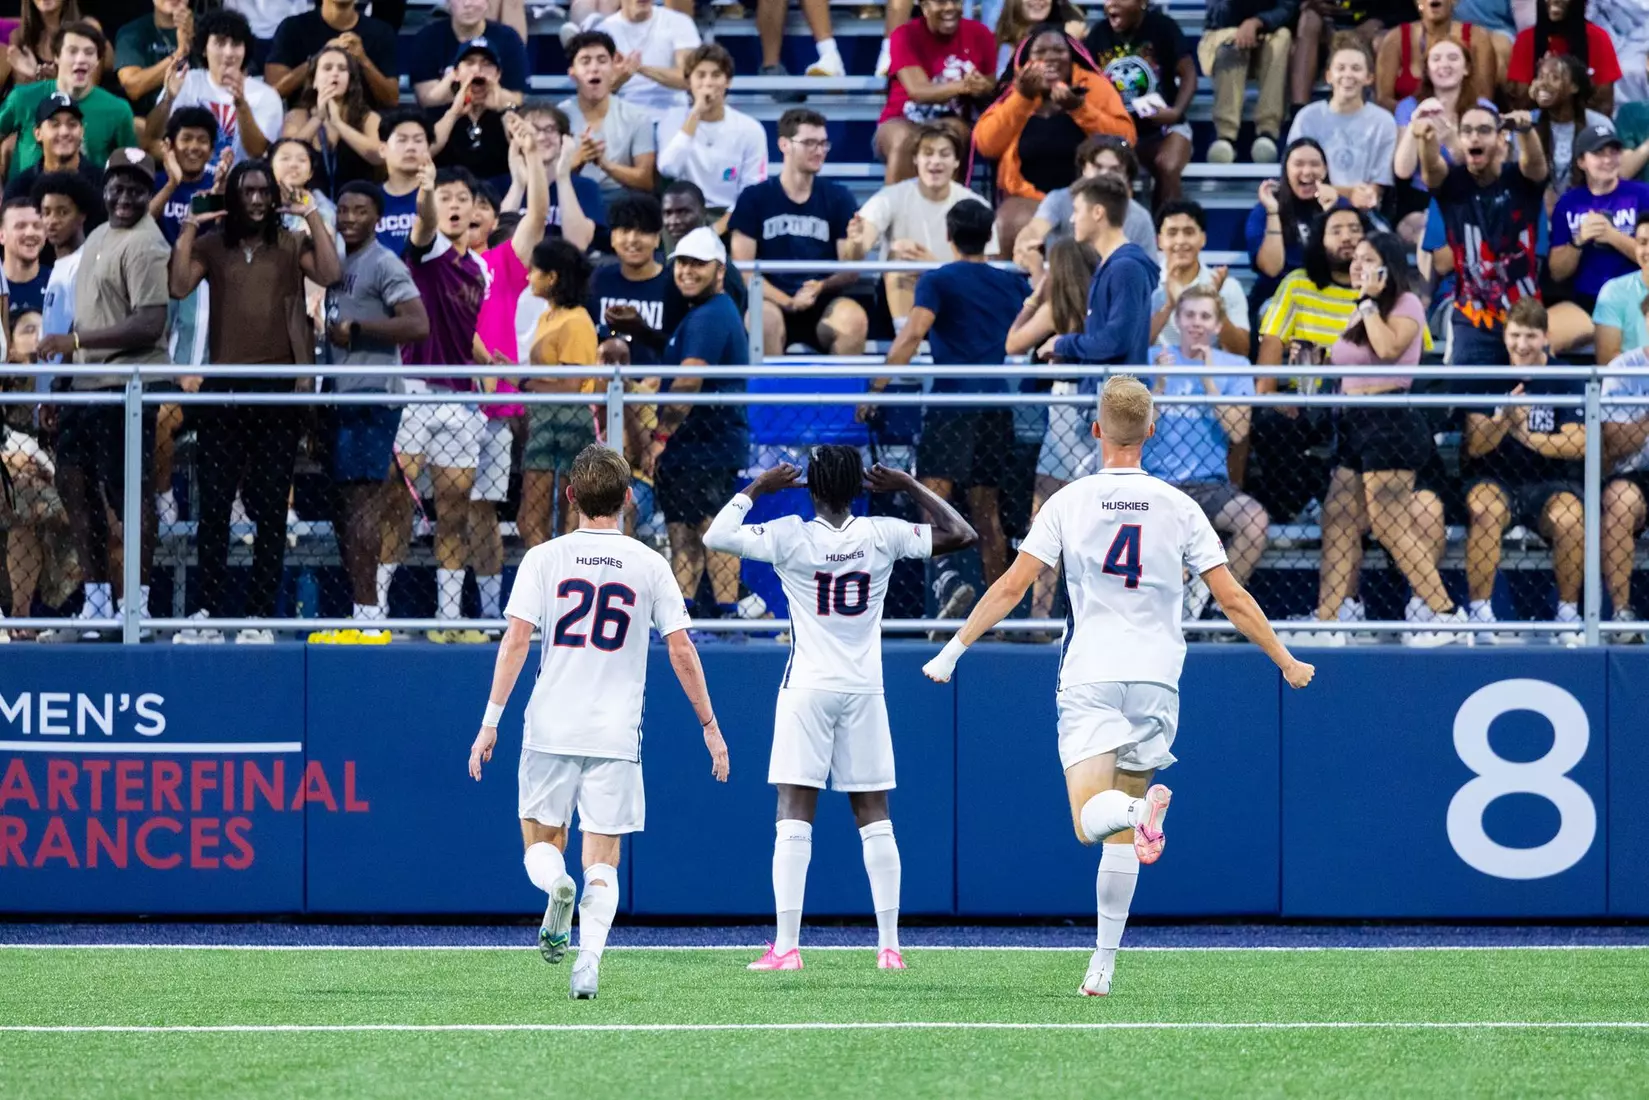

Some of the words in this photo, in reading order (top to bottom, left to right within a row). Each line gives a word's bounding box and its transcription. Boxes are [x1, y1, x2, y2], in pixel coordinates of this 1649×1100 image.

[1102, 501, 1149, 511] HUSKIES
[576, 556, 623, 569] HUSKIES
[1102, 524, 1143, 589] 4
[553, 578, 637, 652] 26
[814, 571, 871, 617] 10
[0, 692, 166, 736] MEN'S
[0, 758, 370, 812] ARTERFINAL
[1446, 678, 1597, 880] 8
[0, 816, 255, 869] RANCES
